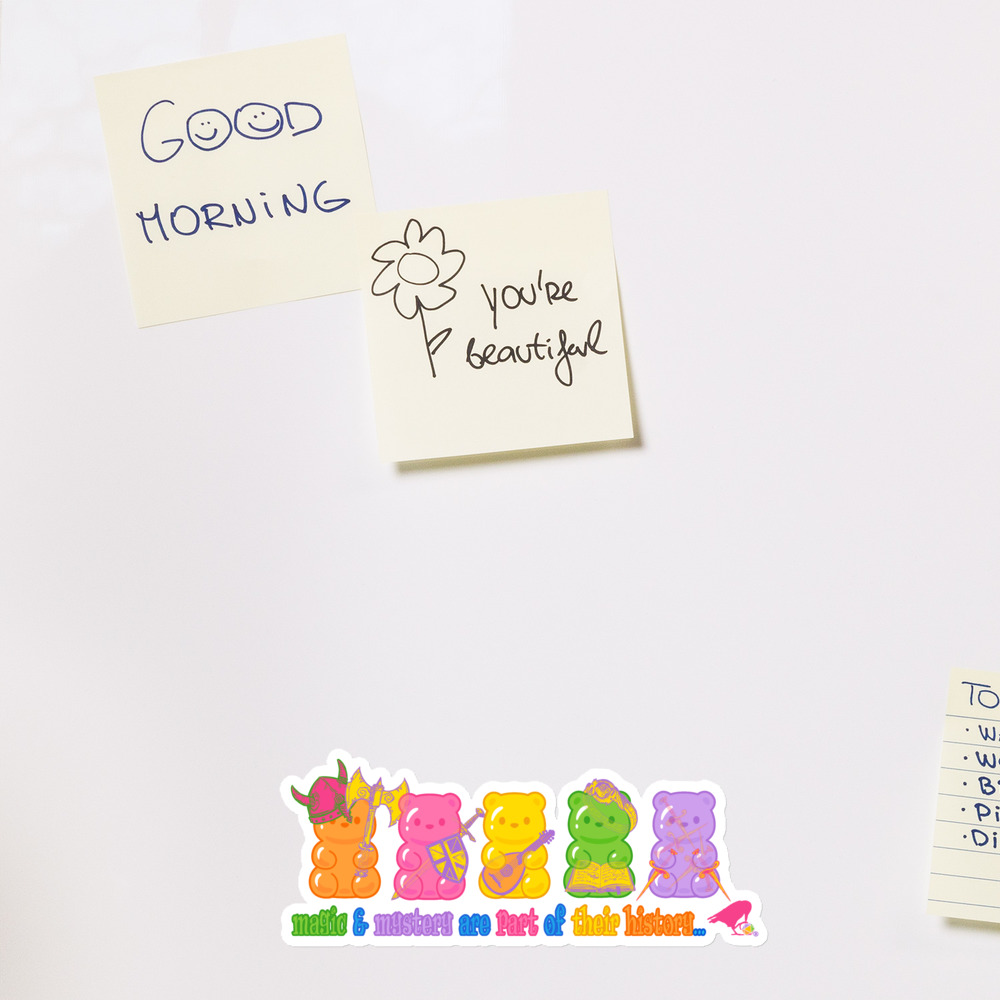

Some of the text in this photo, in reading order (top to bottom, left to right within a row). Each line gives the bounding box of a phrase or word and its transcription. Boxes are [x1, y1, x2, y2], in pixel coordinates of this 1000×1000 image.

[140, 99, 323, 163] GOOD
[466, 319, 608, 387] beautiful
[961, 681, 1000, 709] TO
[291, 904, 348, 936] magic
[352, 906, 369, 936] &
[373, 907, 454, 936] mystery
[458, 912, 491, 936] are
[543, 903, 567, 936] of
[570, 903, 621, 936] their
